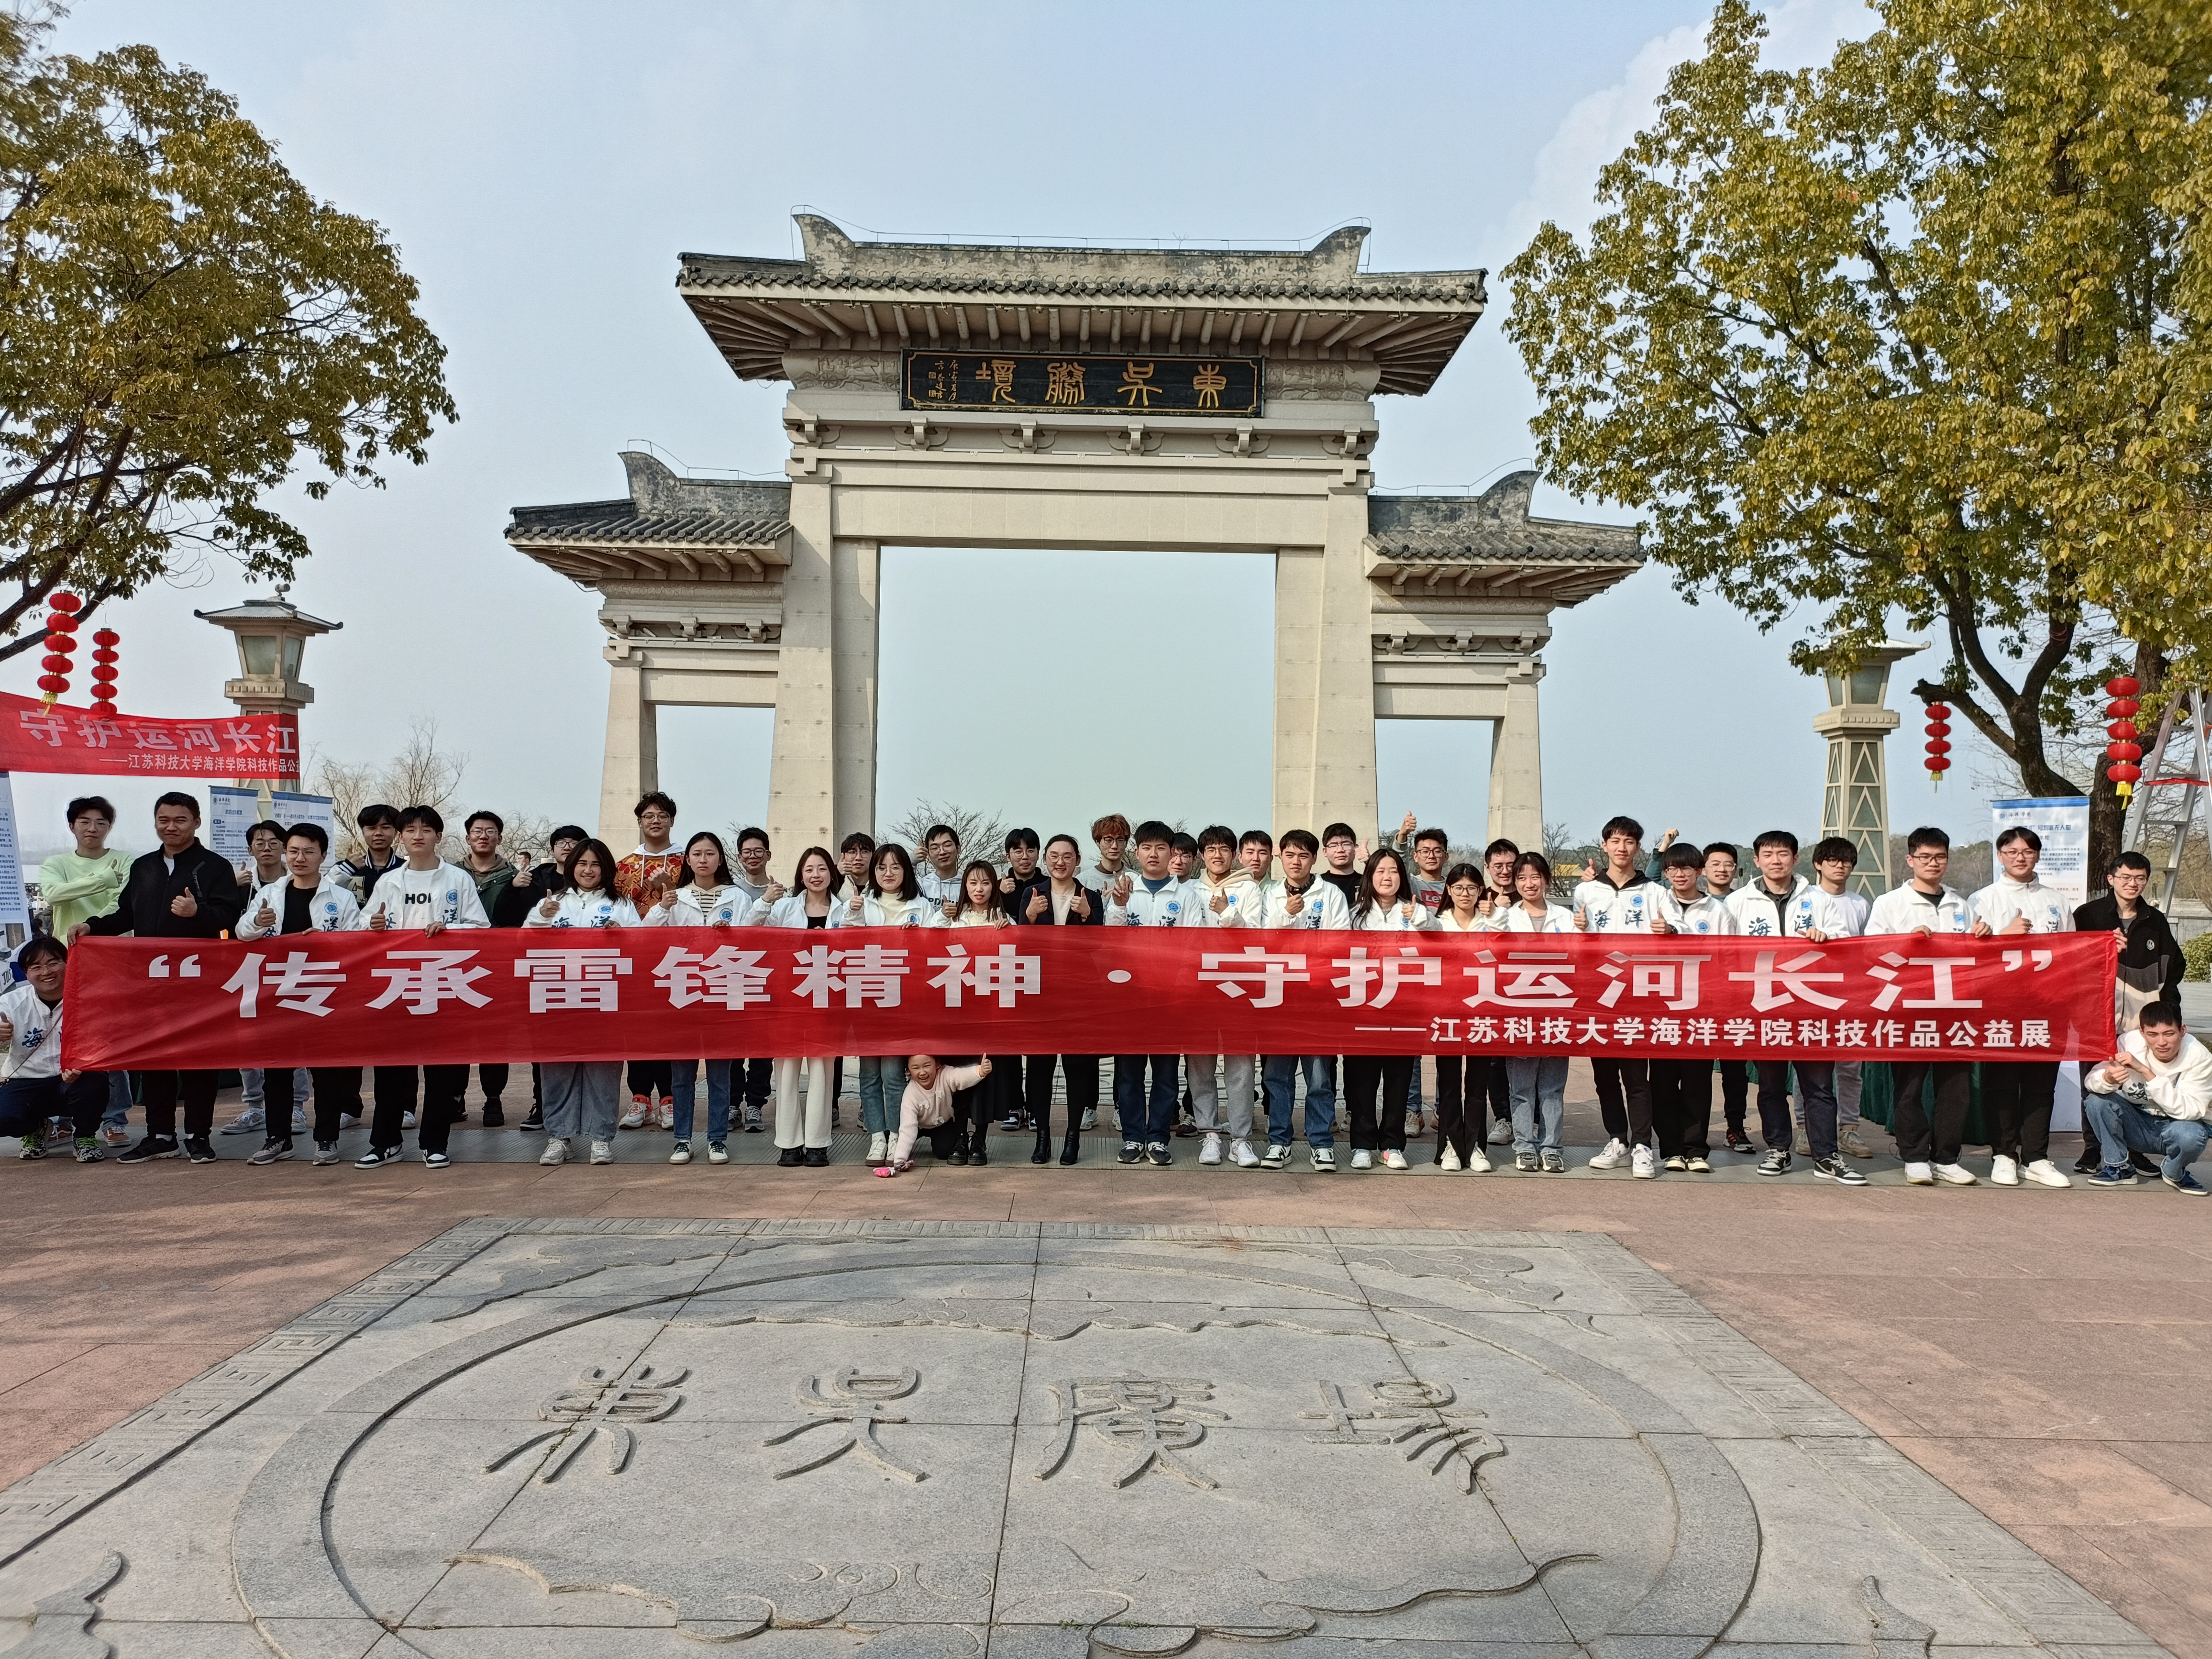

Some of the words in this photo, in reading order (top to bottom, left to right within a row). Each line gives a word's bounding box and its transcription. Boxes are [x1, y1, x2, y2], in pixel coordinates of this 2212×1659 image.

[20, 708, 296, 754] 守护运河长江
[1355, 1016, 2052, 1048] ——江苏科技大学海洋学院科技作品公益展
